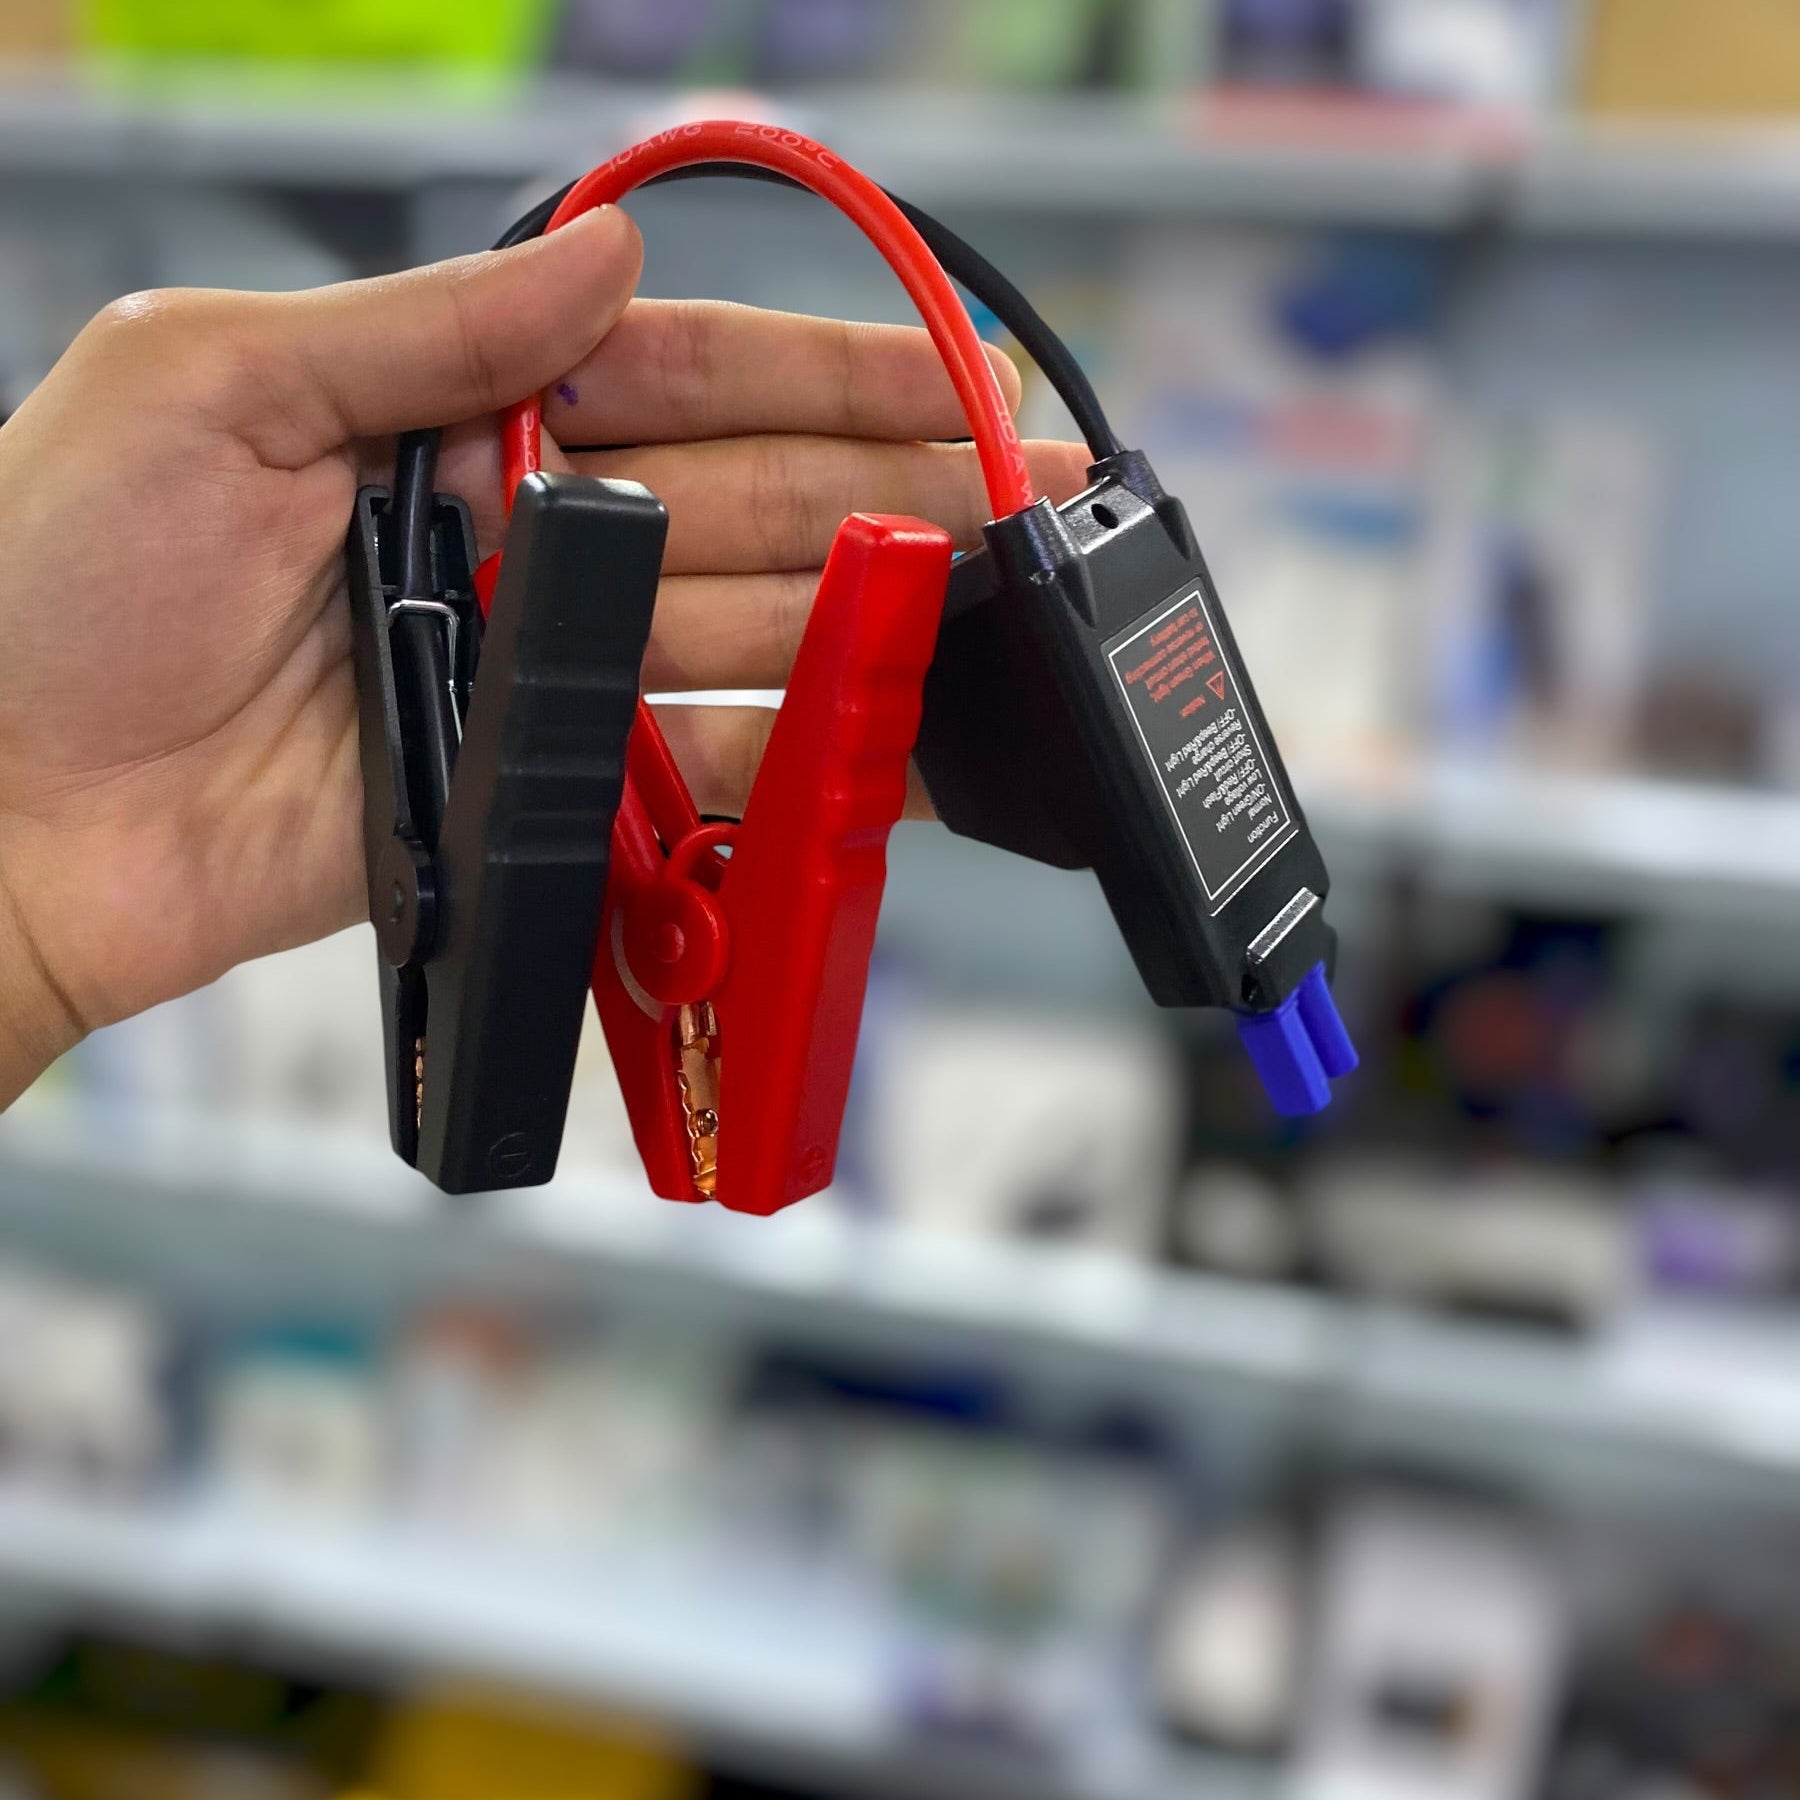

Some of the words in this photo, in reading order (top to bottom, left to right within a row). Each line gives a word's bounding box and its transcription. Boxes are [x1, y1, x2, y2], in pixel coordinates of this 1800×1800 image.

[608, 122, 703, 172] 10AWG
[1213, 718, 1242, 745] Reverse
[1164, 750, 1184, 772] Light
[1191, 740, 1215, 765] charge
[1231, 743, 1252, 765] Short
[1212, 758, 1234, 782] circuit
[1246, 768, 1262, 785] Low
[1175, 776, 1195, 798] Light
[1223, 780, 1248, 805] voltage
[1247, 792, 1272, 820] Normal
[1215, 811, 1234, 832] Light
[1246, 810, 1279, 843] Function
